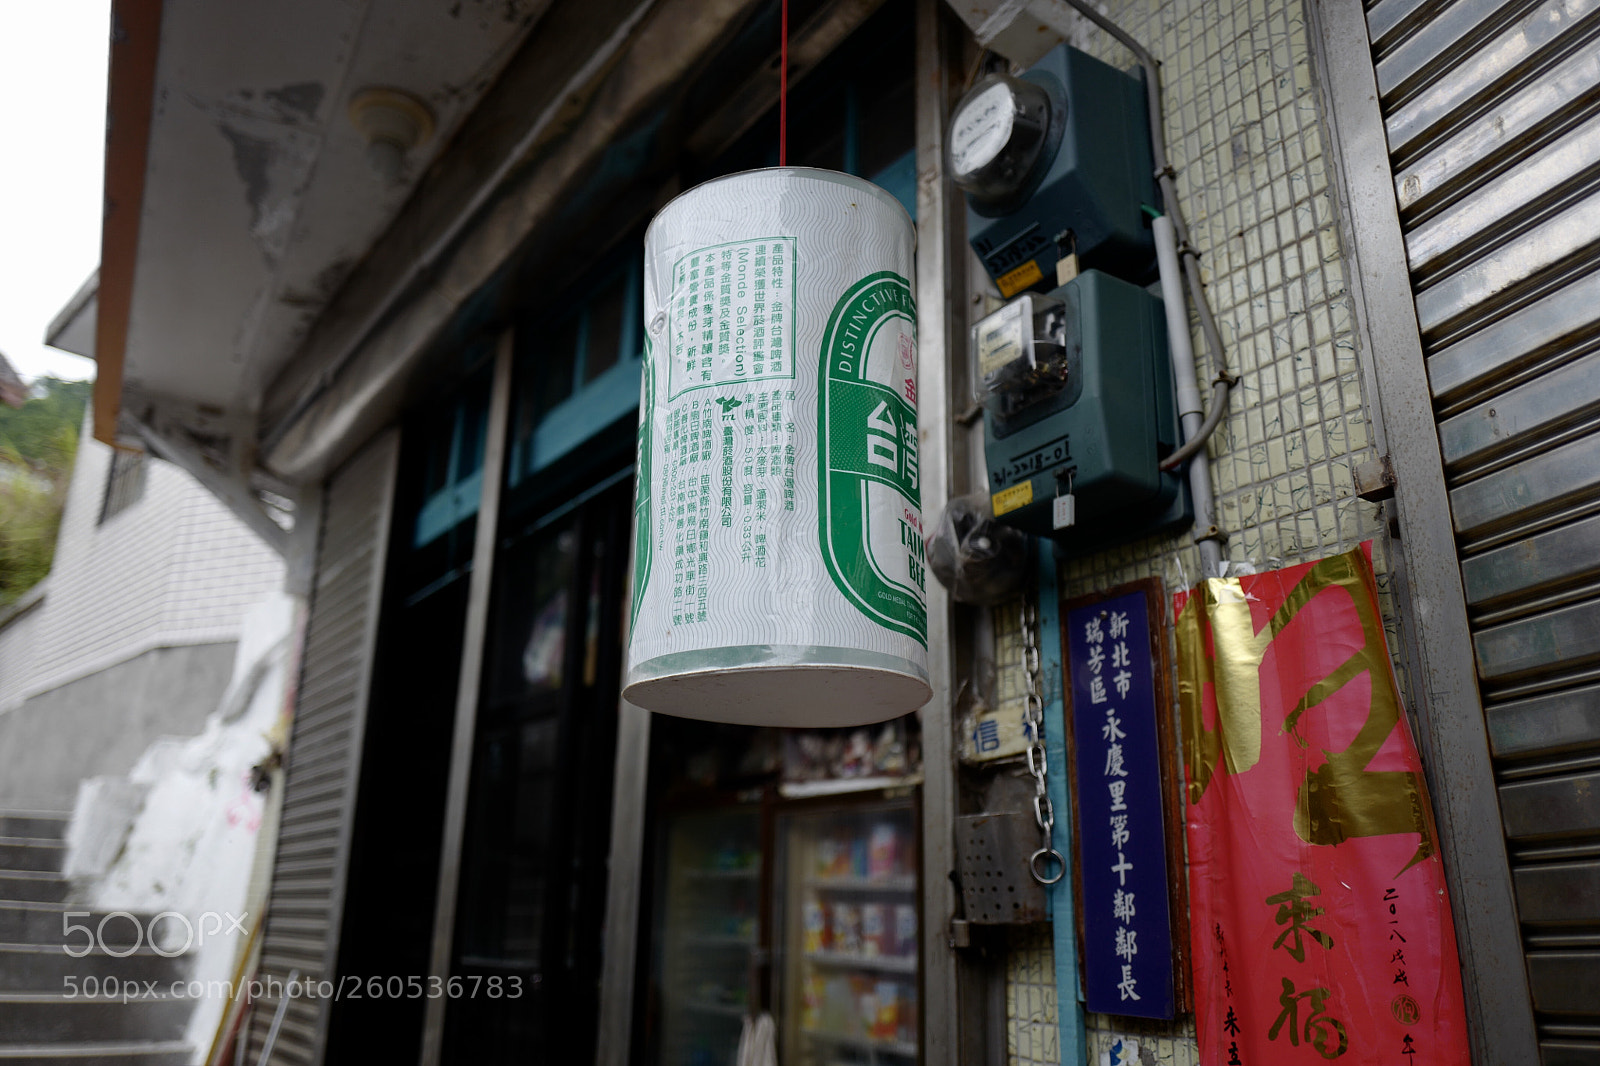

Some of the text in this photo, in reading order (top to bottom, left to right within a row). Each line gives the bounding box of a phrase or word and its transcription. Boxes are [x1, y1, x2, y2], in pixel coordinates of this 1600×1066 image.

[734, 247, 750, 376] (Monde Selection)
[838, 288, 899, 373] DISTINCTIVE
[1085, 617, 1108, 704] 瑞芳區
[1109, 611, 1132, 700] 新北市
[1102, 708, 1141, 1001] 永慶里第十鄰鄰長
